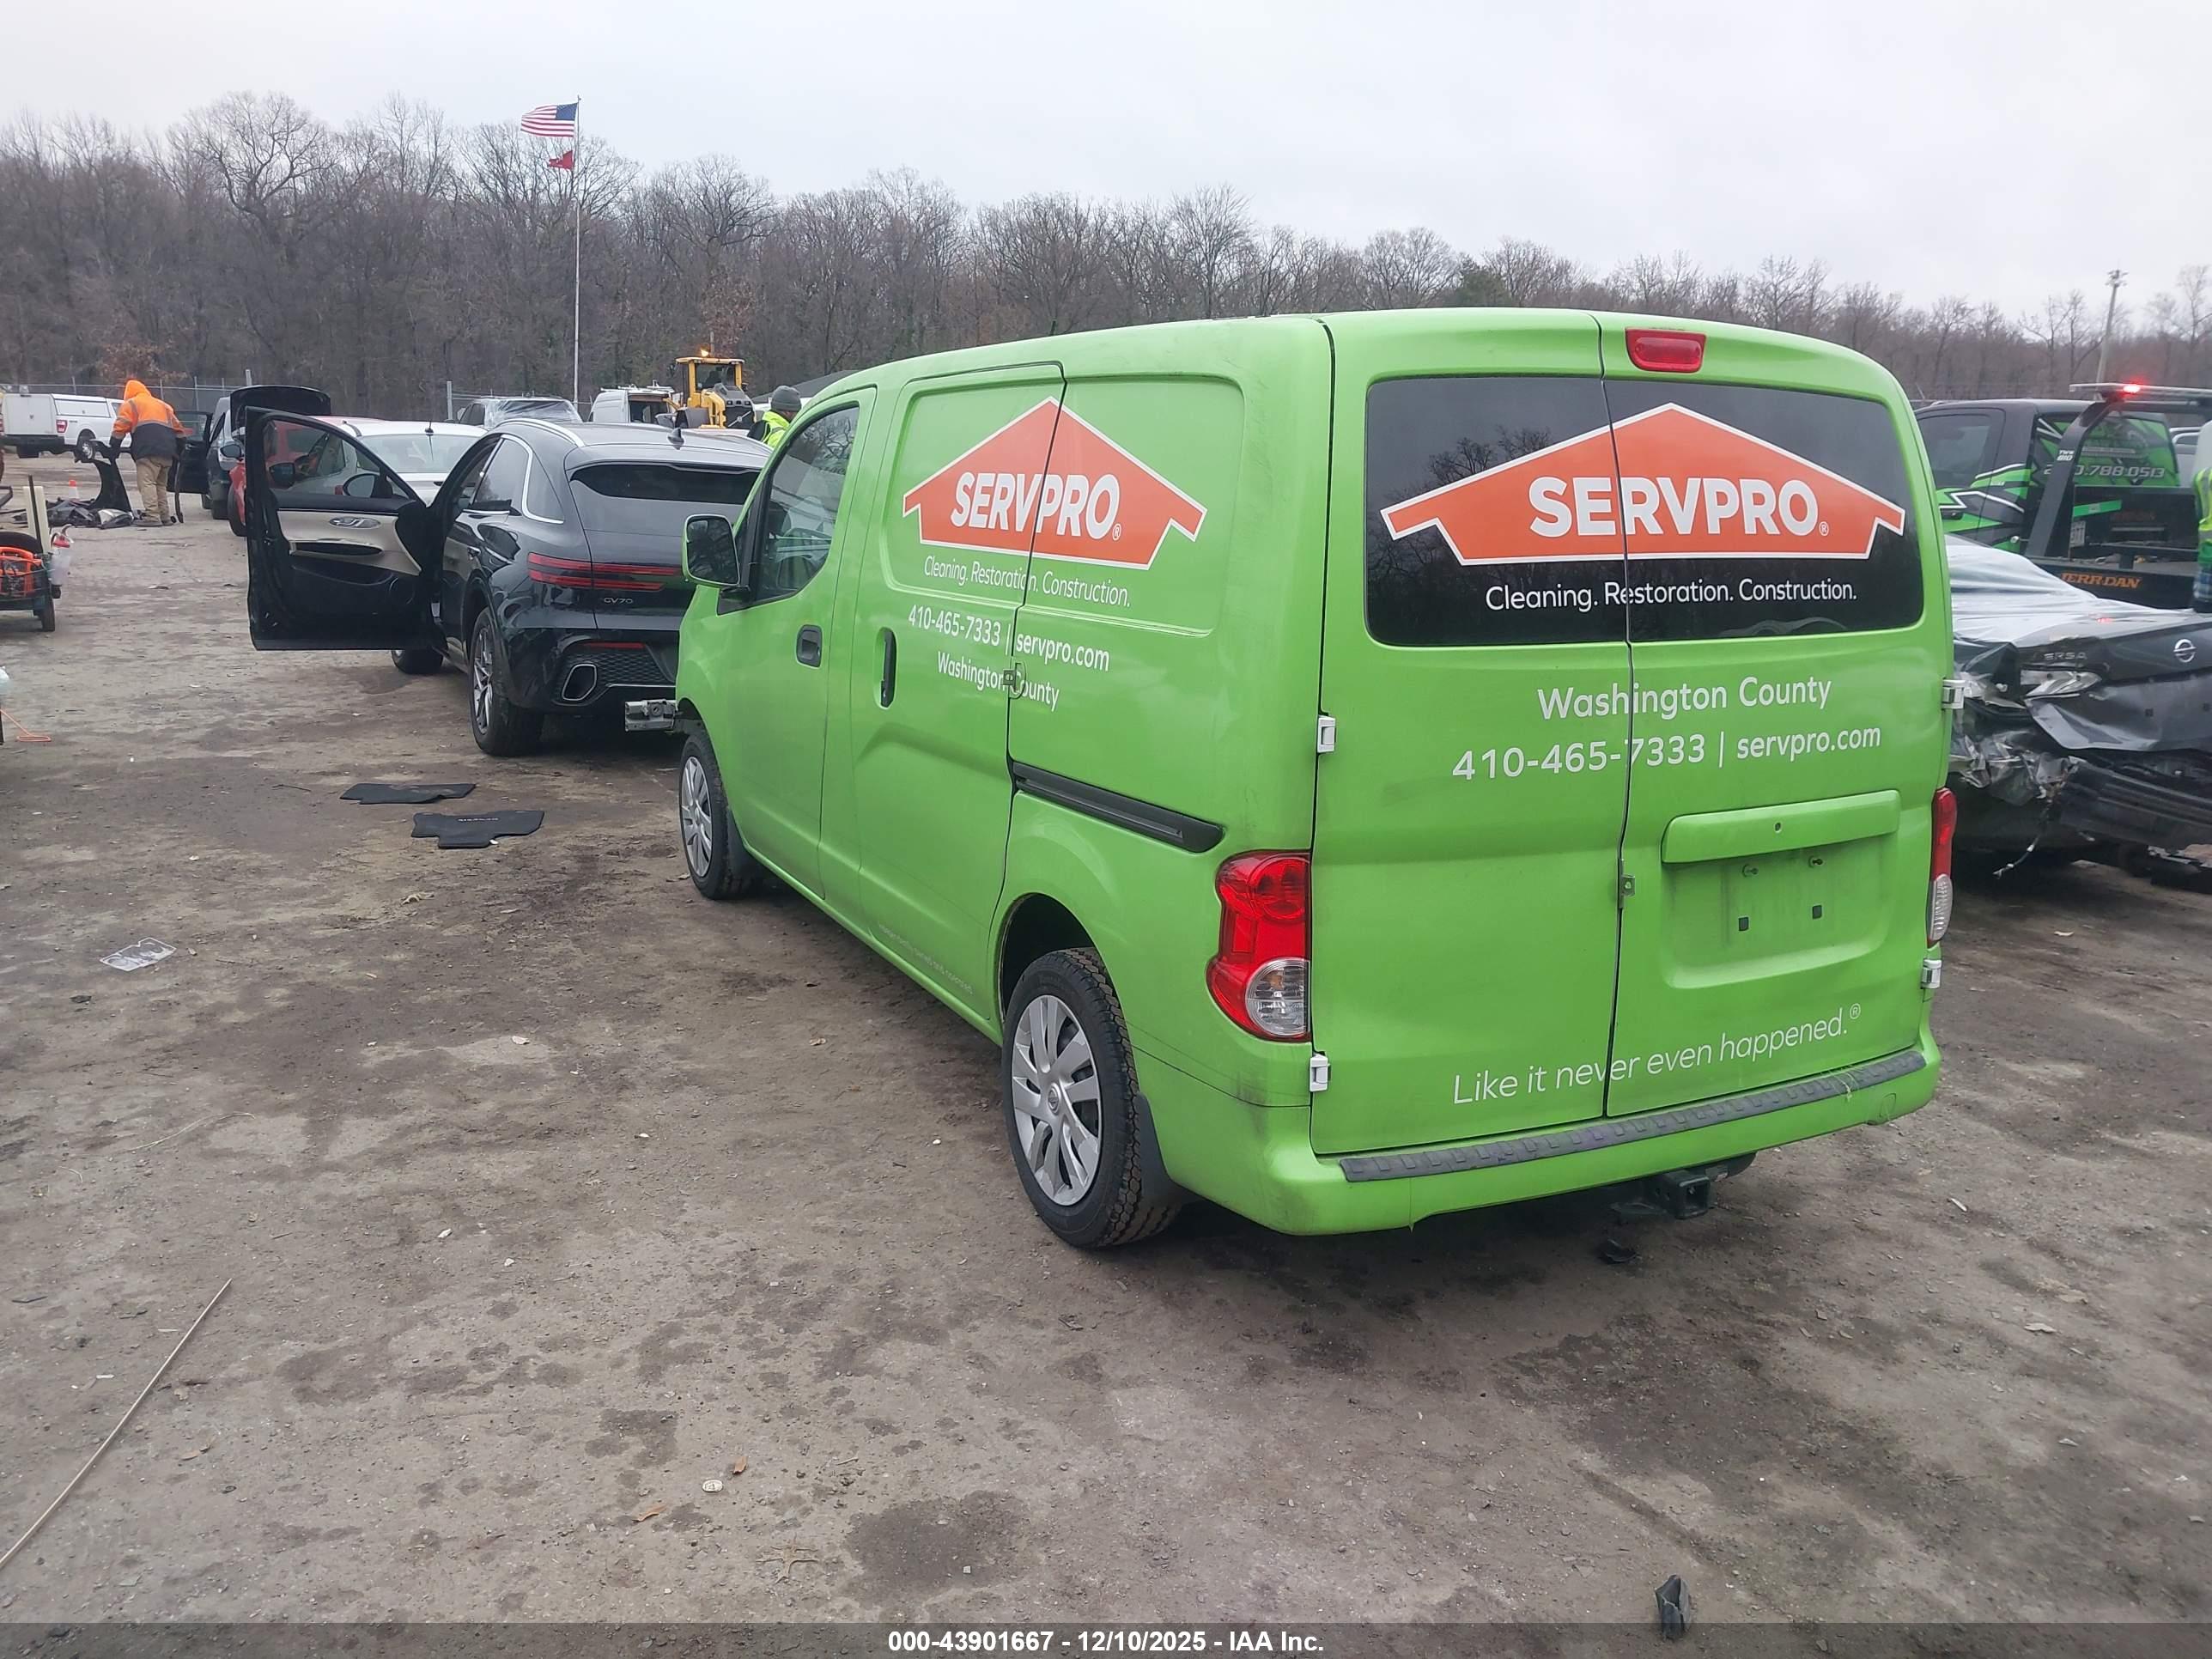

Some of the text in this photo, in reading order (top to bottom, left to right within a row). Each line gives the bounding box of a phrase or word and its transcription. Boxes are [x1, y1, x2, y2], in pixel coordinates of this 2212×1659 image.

[924, 556, 1131, 607] Cleaning. Restoration. Construction.
[1486, 576, 1858, 612] Cleaning. Restoration. Construction.
[908, 605, 1001, 646] 410-465-7333
[1016, 631, 1109, 672] servpro.com
[1537, 677, 1832, 720] Washington County
[1452, 733, 1705, 781] 410-465-7333
[1737, 726, 1881, 762] servpro.com
[1454, 1072, 1517, 1104] Like
[1528, 1069, 1547, 1092] it
[1555, 1054, 1640, 1090] never
[1647, 1043, 1712, 1075] even
